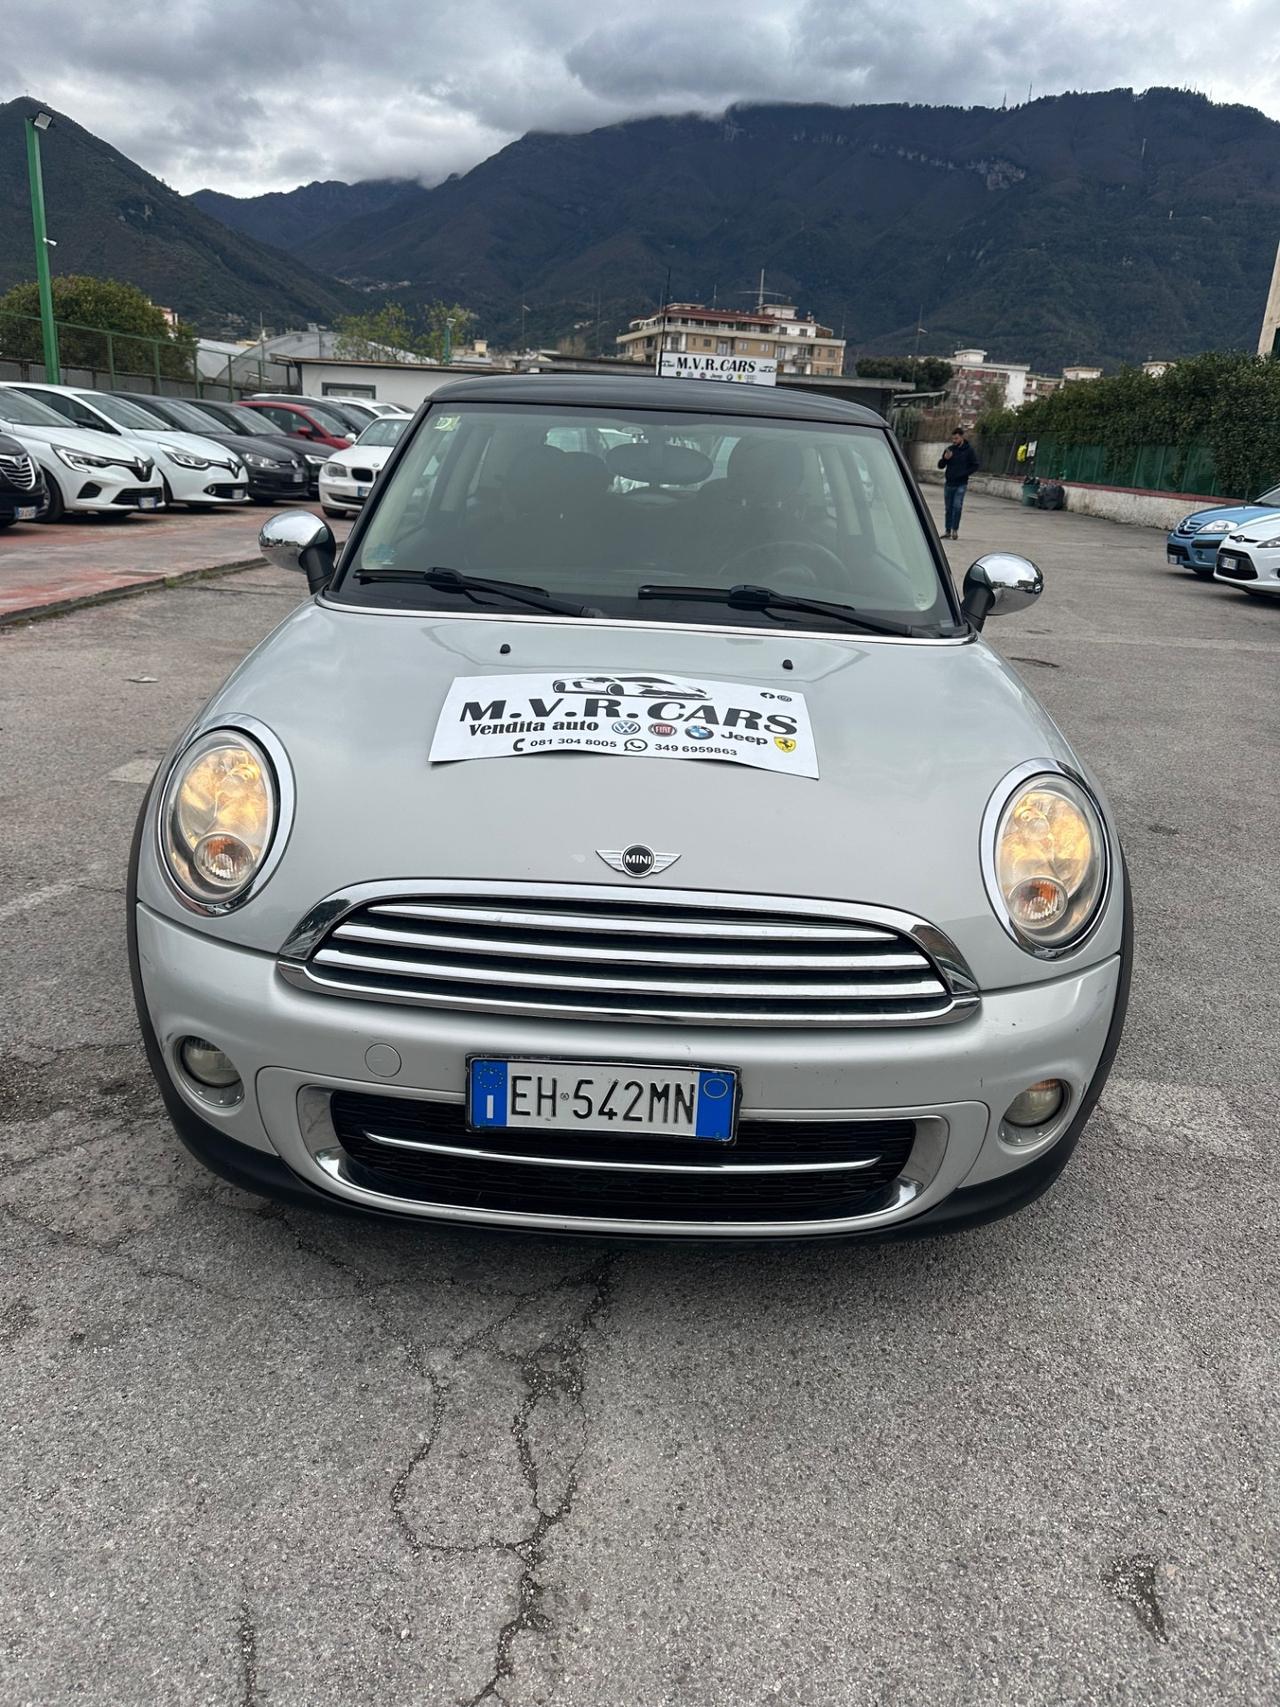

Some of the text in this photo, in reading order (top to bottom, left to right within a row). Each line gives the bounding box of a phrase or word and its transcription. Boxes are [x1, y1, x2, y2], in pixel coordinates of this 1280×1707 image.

[469, 719, 600, 736] Vendita auto
[654, 725, 672, 735] FIAT
[530, 737, 617, 748] 081 304 8005
[720, 731, 768, 746] Jeep
[654, 743, 738, 756] 349 6959863
[626, 854, 652, 865] MINI
[511, 1075, 697, 1125] EH 542MN
